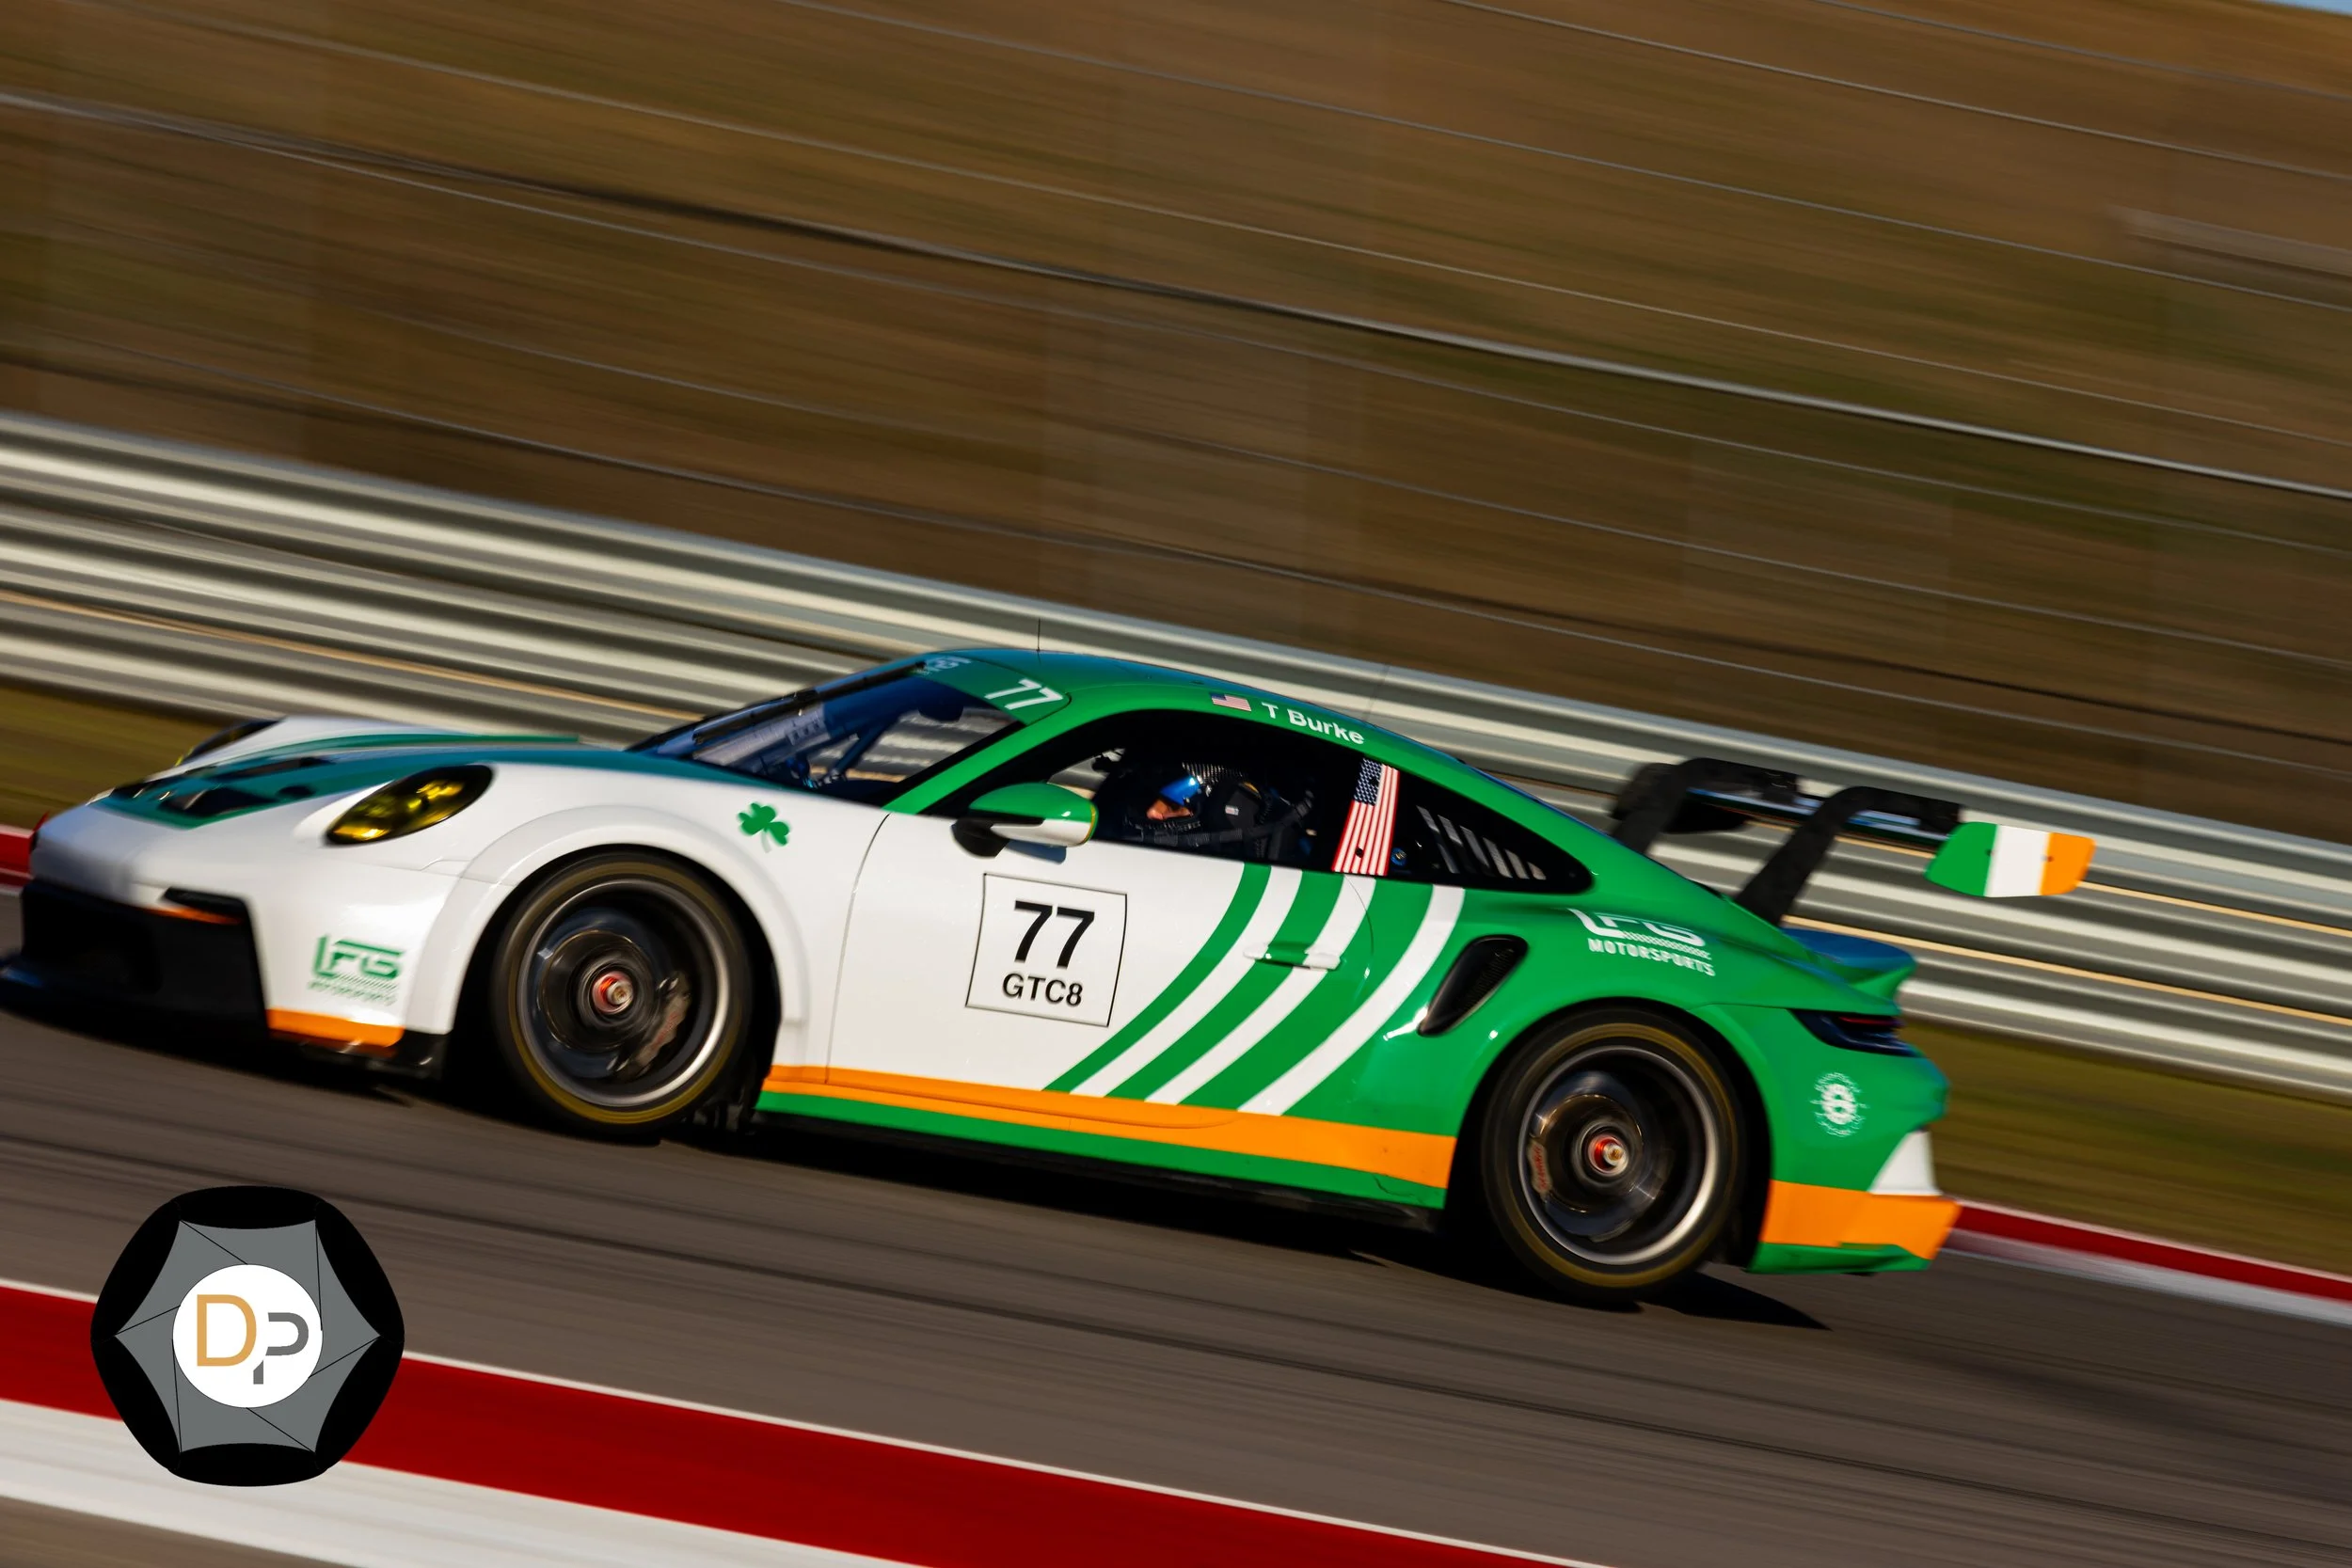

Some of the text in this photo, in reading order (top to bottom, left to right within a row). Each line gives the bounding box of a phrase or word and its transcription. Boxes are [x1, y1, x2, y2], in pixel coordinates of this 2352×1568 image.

[984, 677, 1063, 710] 77
[1261, 702, 1365, 745] T Burke
[1013, 899, 1096, 971] 77
[1586, 937, 1717, 977] MOTORSPORTS
[1001, 972, 1084, 1007] GTC8
